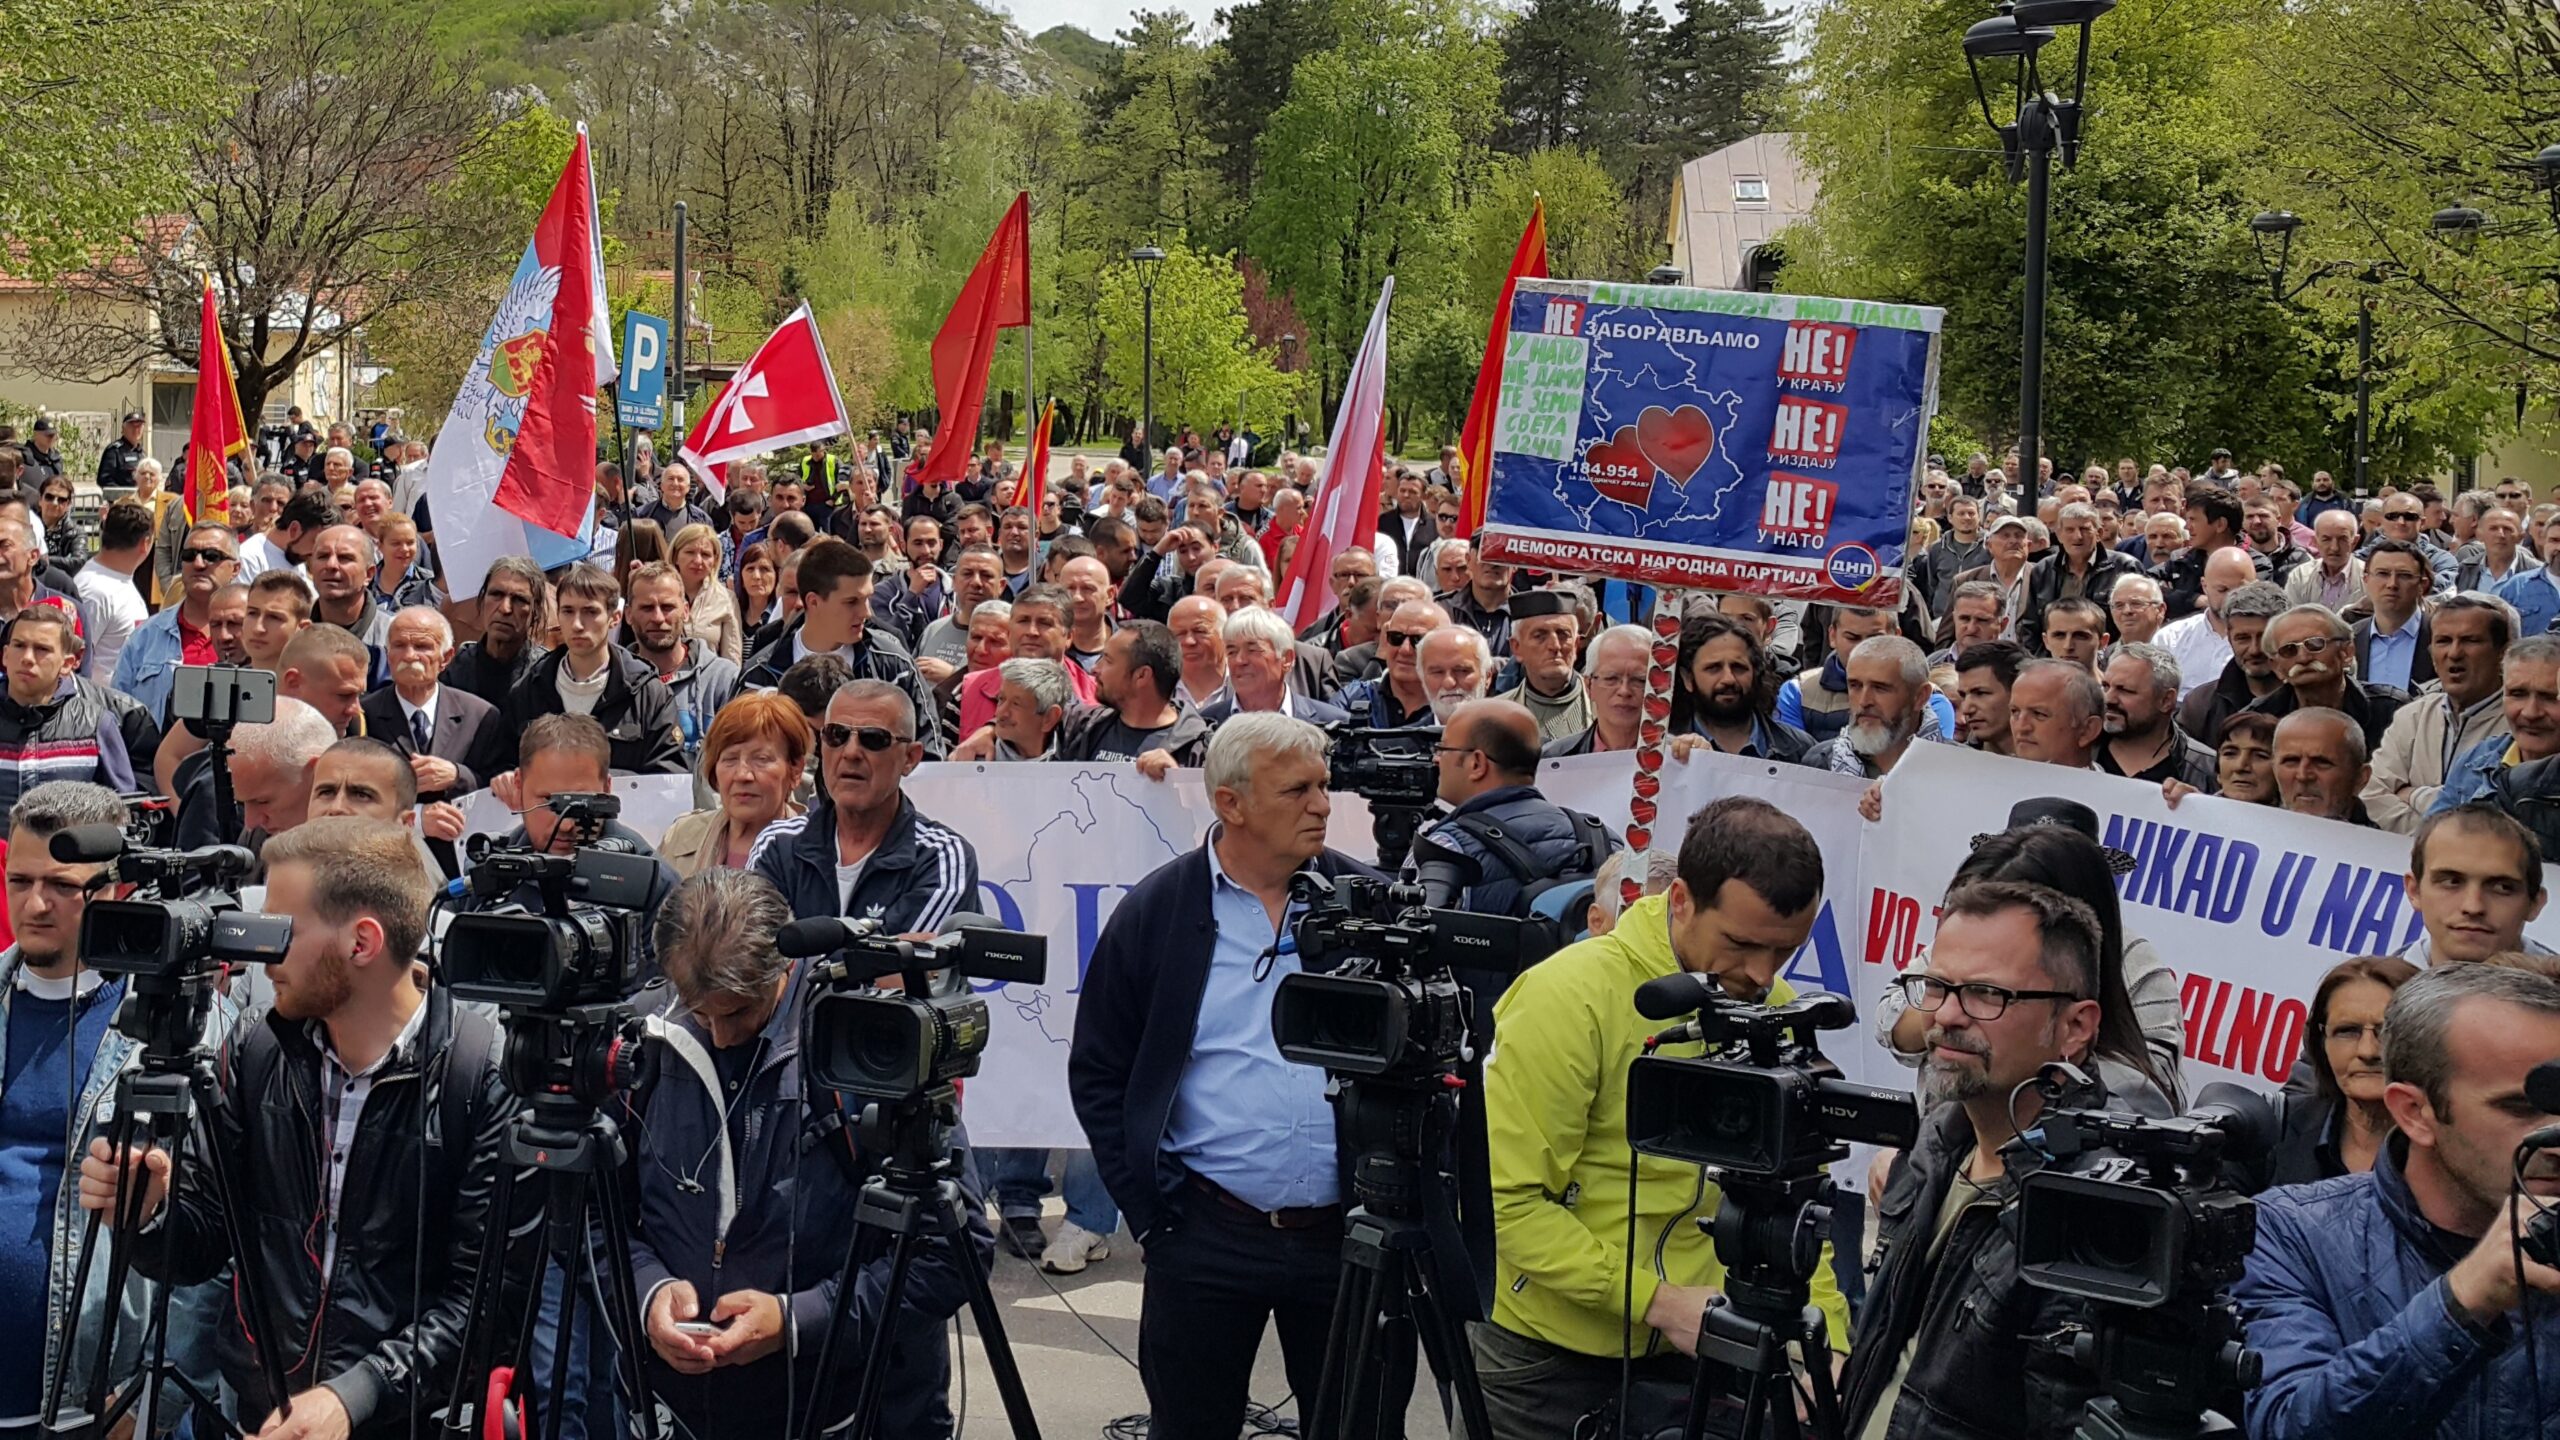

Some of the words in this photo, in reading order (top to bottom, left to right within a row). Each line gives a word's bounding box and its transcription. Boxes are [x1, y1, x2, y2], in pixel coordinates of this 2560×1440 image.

[1543, 302, 1578, 336] НЕ
[1584, 321, 1760, 350] ЗАБОРАВЉАМО
[1850, 300, 1926, 331] ПАКТА
[629, 322, 660, 392] P
[1507, 333, 1527, 358] У
[1528, 335, 1584, 366] НАТО
[1782, 326, 1846, 376] НЕ!
[1502, 360, 1530, 386] НЕ
[1531, 364, 1586, 391] ДАМО
[1776, 376, 1786, 388] У
[1790, 378, 1846, 393] КРАЂУ
[1501, 384, 1524, 409] ТЕ
[1504, 412, 1568, 438] СВЕТА
[1773, 403, 1837, 453] НЕ!
[1570, 461, 1639, 480] 184.954
[1766, 452, 1776, 464] У
[1779, 453, 1837, 470] ИЗДАЈУ
[1764, 479, 1828, 530] НЕ!
[1757, 528, 1768, 544] У
[1773, 531, 1825, 550] НАТО
[1505, 537, 1635, 566] ДЕМОКРАТСКА
[1640, 551, 1728, 577] НАРОДНА
[1733, 563, 1819, 587] ПАРТИЈА
[1831, 559, 1873, 575] ДНП
[2103, 813, 2261, 924] NIKAD
[2260, 851, 2318, 937] U
[868, 942, 887, 950] SONY
[1453, 935, 1491, 947] XDCAM
[1729, 1015, 1750, 1024] SONY
[2168, 967, 2308, 1084] ALNO
[1870, 1090, 1902, 1101] SONY
[1821, 1104, 1859, 1120] HDV
[2110, 1122, 2131, 1130] SONY
